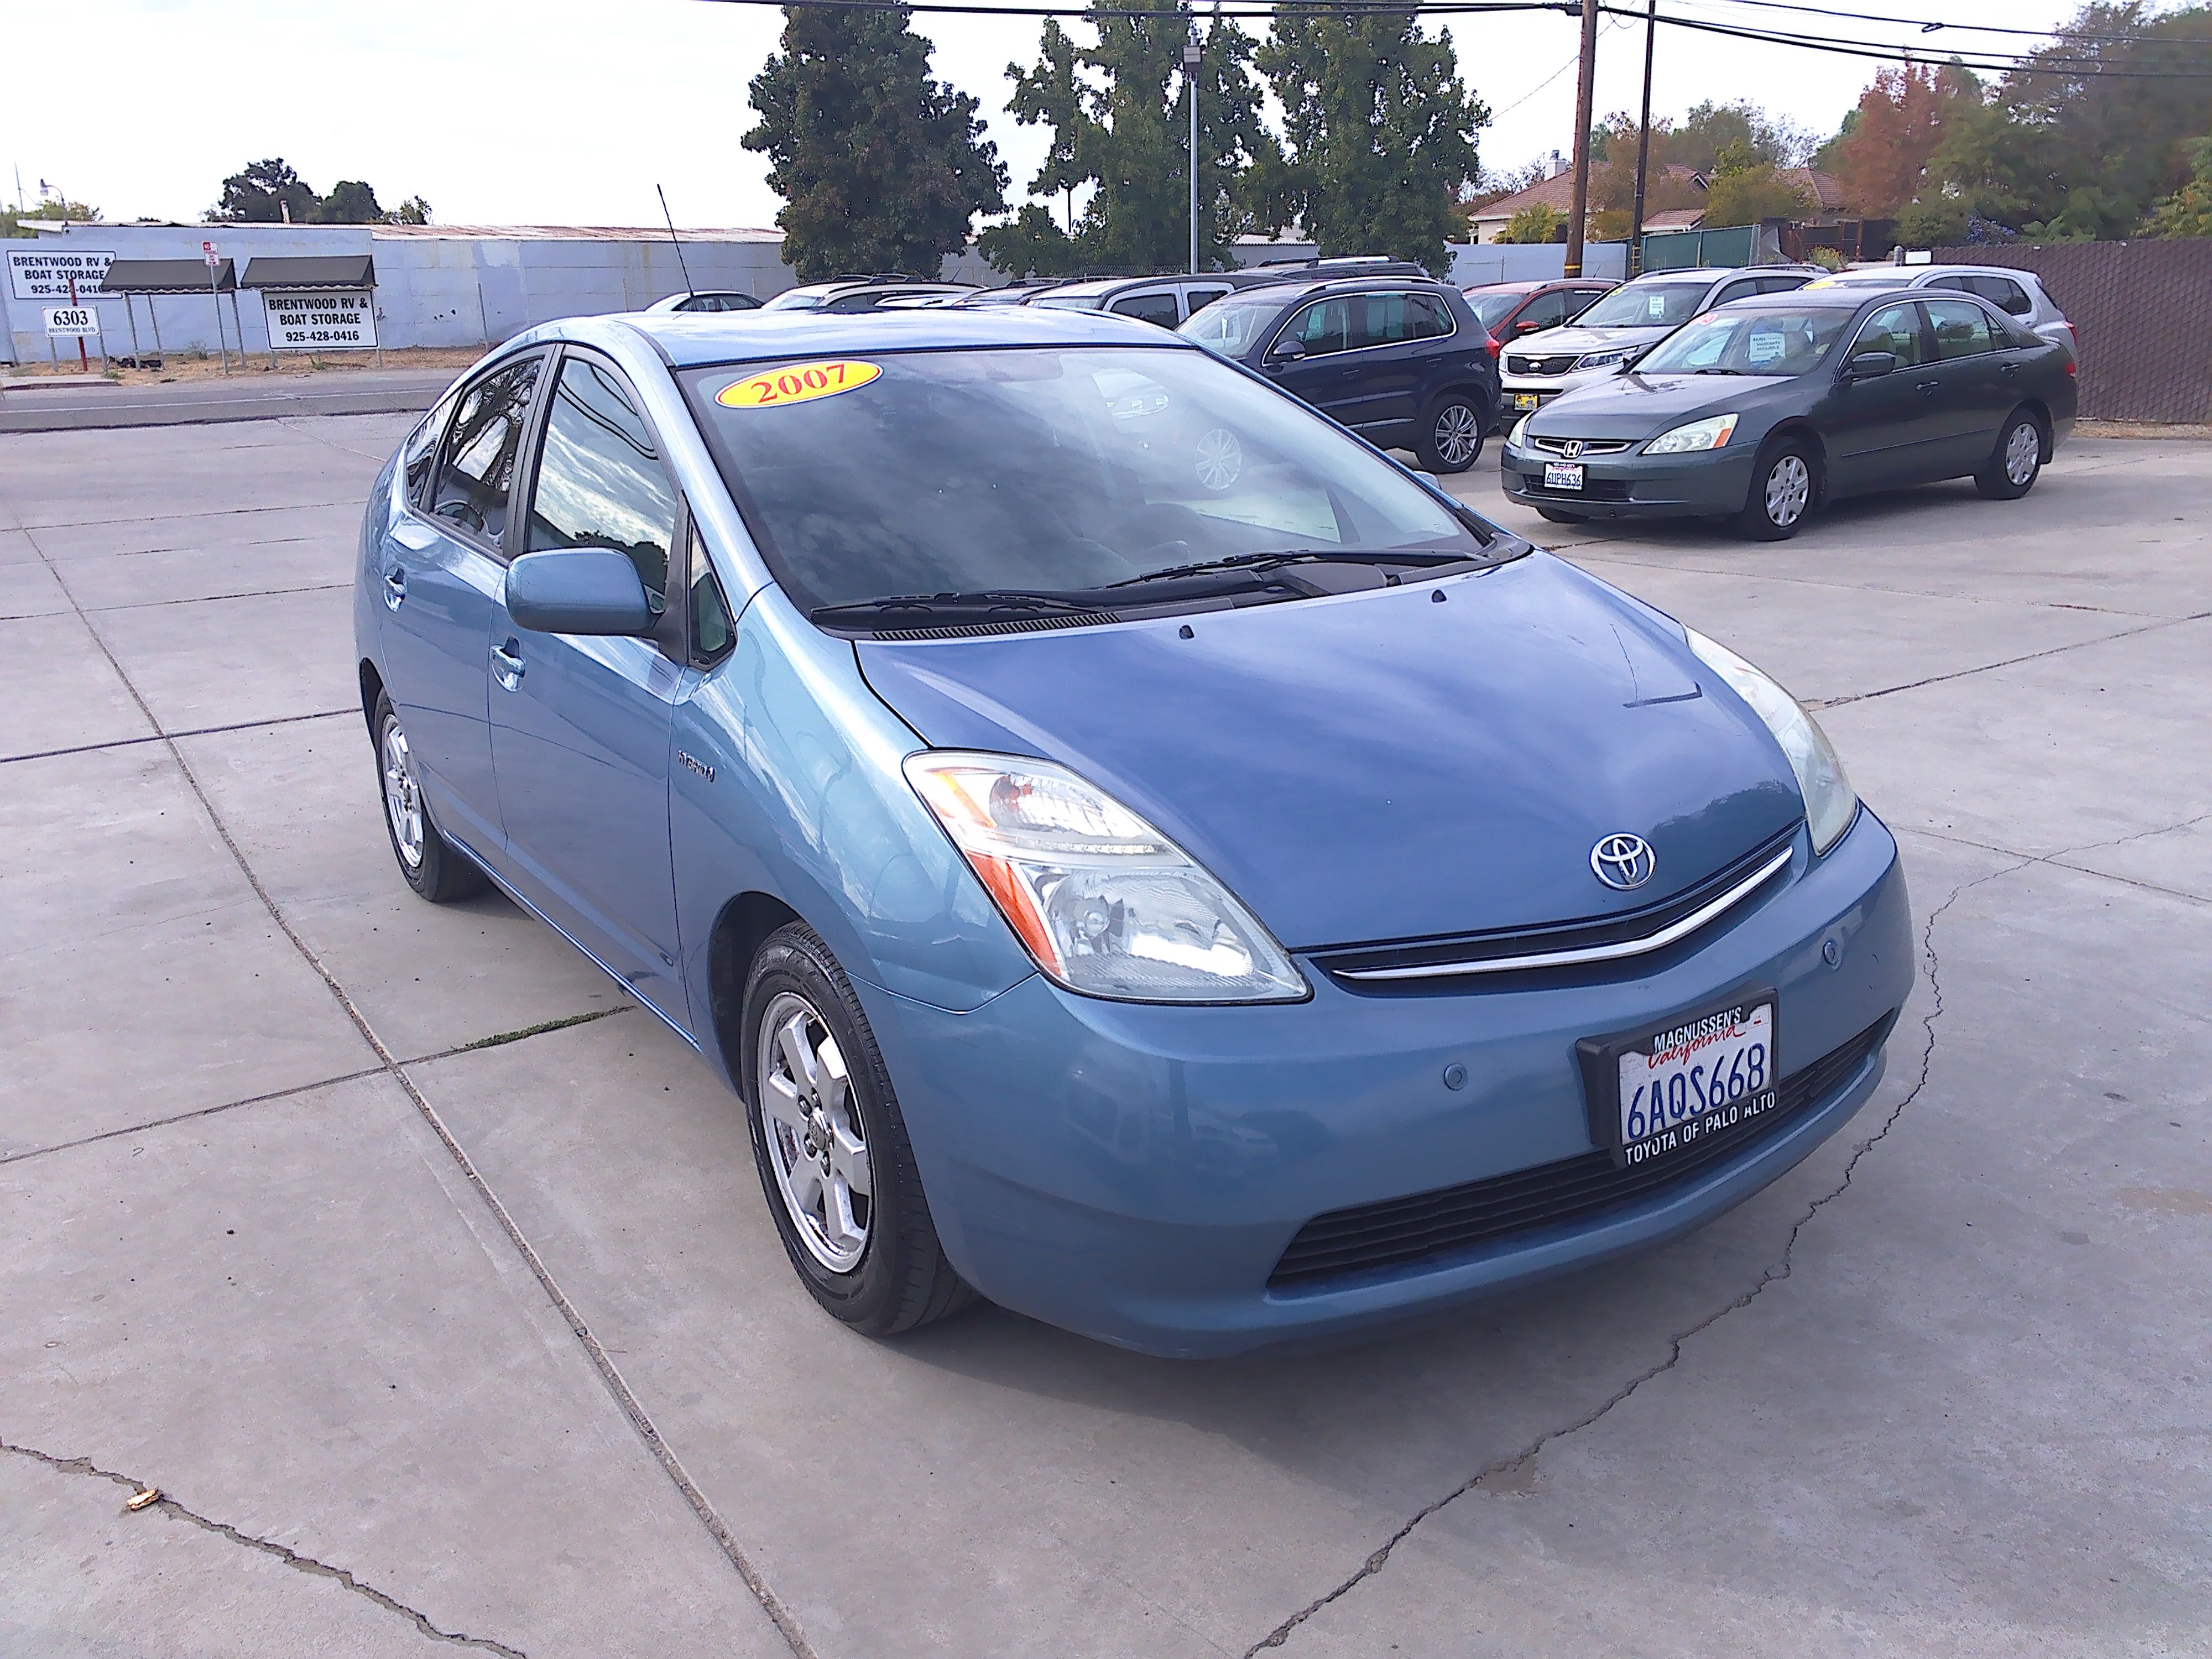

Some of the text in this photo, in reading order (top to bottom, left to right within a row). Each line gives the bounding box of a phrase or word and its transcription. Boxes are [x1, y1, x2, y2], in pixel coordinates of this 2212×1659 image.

[13, 257, 112, 267] BRENTWOOD RV &
[24, 270, 105, 280] BOAT STORAGE
[31, 285, 103, 294] 925-42-0416
[269, 297, 368, 310] BRENTWOOD RV &
[53, 310, 88, 326] 6303
[279, 313, 361, 325] BOAT STORAGE
[286, 331, 359, 342] 925-428-0416
[751, 363, 844, 403] 2007
[1546, 472, 1581, 486] 6UPH636
[1653, 1006, 1741, 1053] MAGNUSSEN'S
[1648, 1025, 1746, 1070] California
[1627, 1043, 1765, 1140] 6AQS668
[1625, 1091, 1776, 1166] TOYOTA OF PALO ALTO
